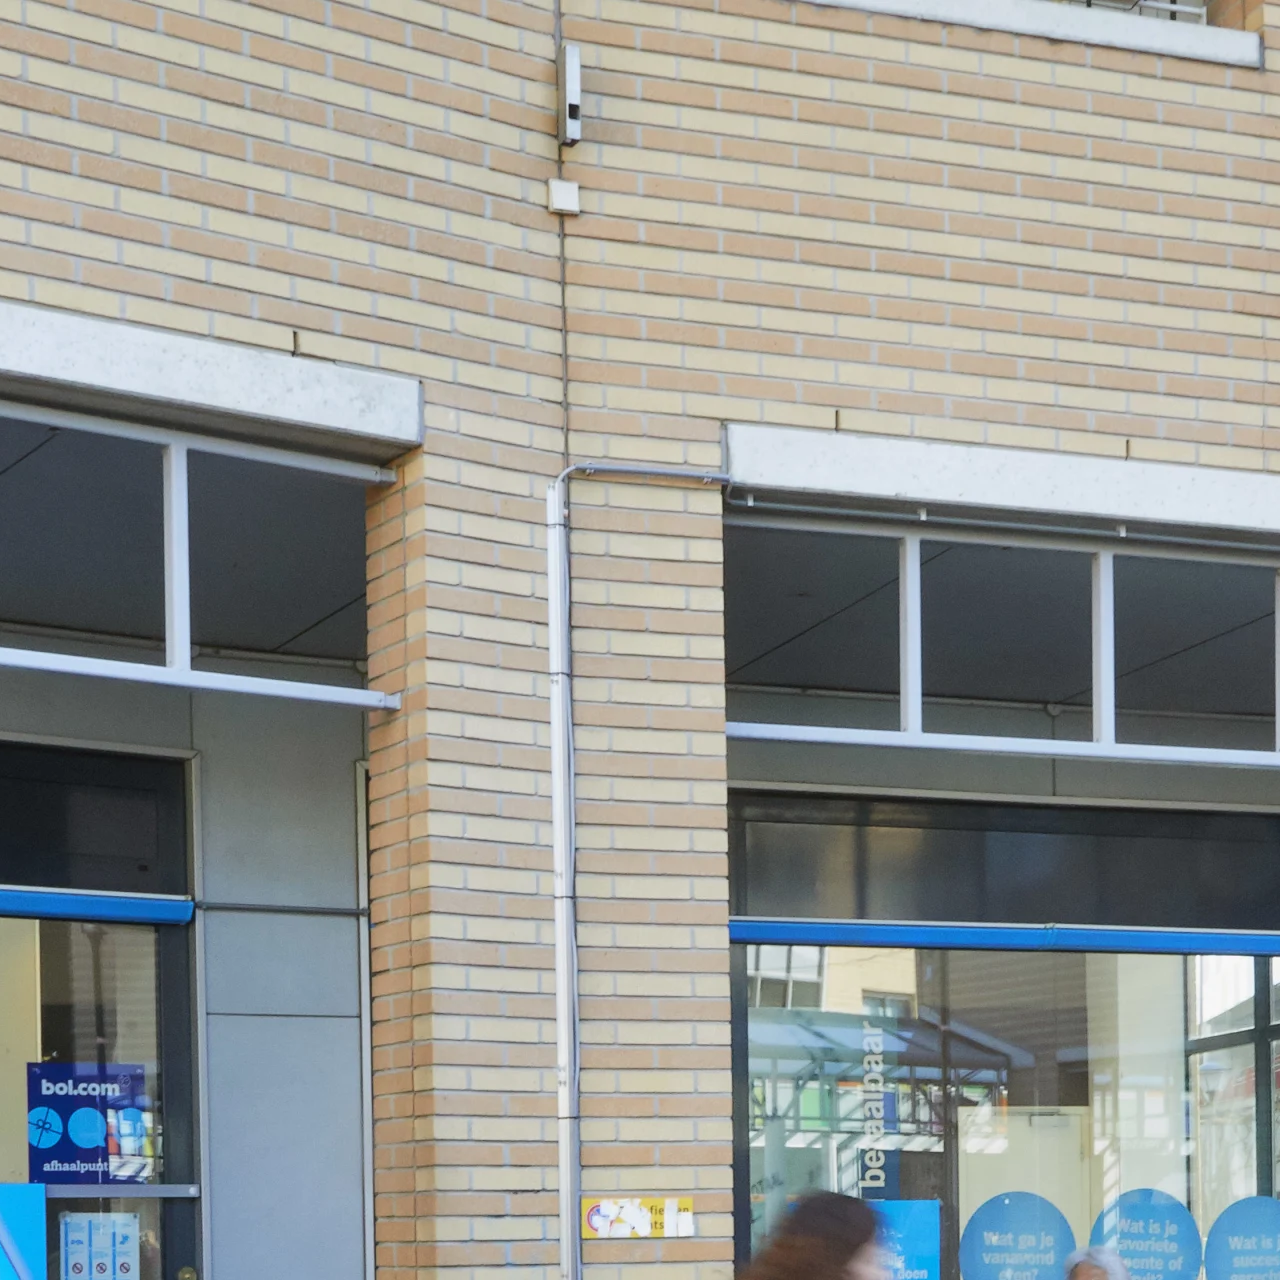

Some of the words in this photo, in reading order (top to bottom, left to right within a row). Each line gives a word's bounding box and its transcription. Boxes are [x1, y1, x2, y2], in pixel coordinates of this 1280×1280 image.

[41, 1079, 121, 1096] bol.com
[43, 1160, 109, 1174] afhaalpunt
[1119, 1219, 1145, 1233] Wat
[1148, 1219, 1160, 1233] is
[1164, 1221, 1178, 1238] je
[983, 1232, 1014, 1246] Wat
[1017, 1234, 1035, 1249] ga
[1040, 1232, 1054, 1249] je
[1119, 1238, 1178, 1252] avoriete
[1228, 1235, 1257, 1250] Wat
[1261, 1235, 1273, 1248] is
[982, 1252, 1055, 1265] vanavond
[1169, 1257, 1184, 1271] of
[897, 1267, 928, 1280] doen
